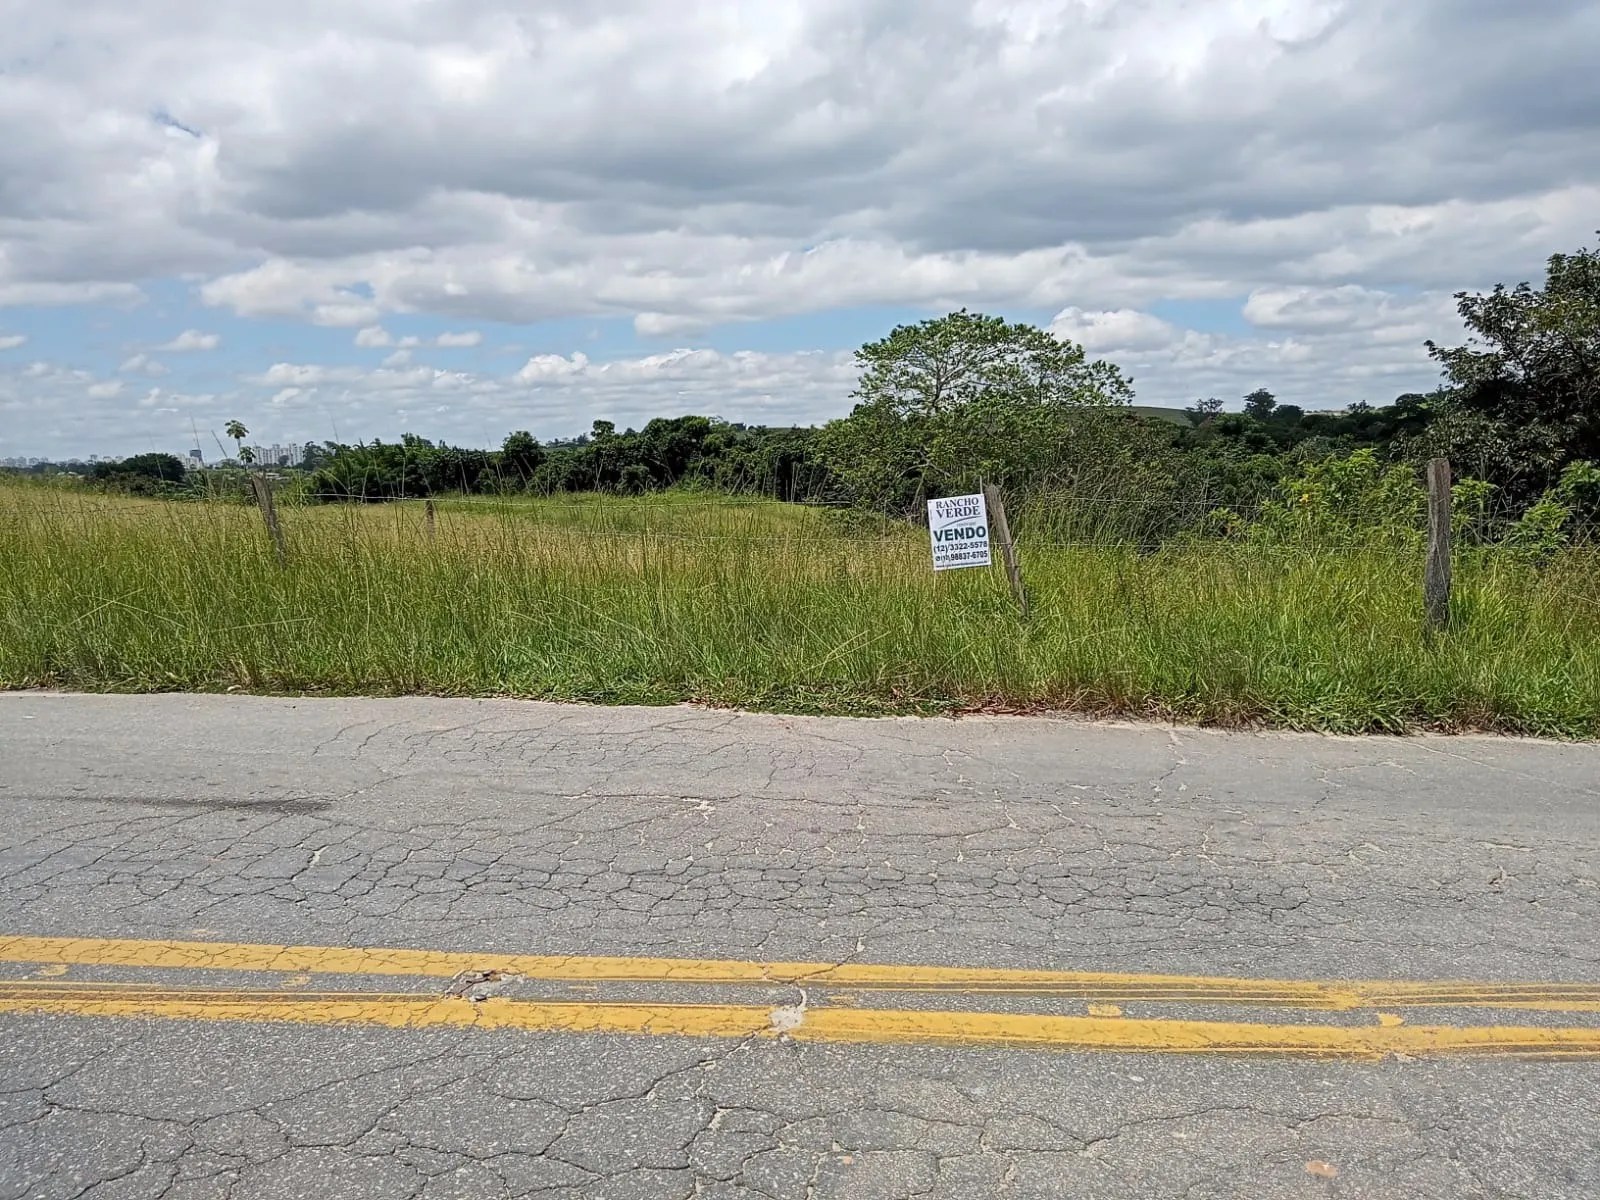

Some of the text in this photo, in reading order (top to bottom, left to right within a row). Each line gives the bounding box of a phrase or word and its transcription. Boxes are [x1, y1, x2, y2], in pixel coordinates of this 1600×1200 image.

[935, 497, 979, 509] RANCHO
[935, 505, 980, 519] VERDE
[933, 525, 986, 542] VENDO
